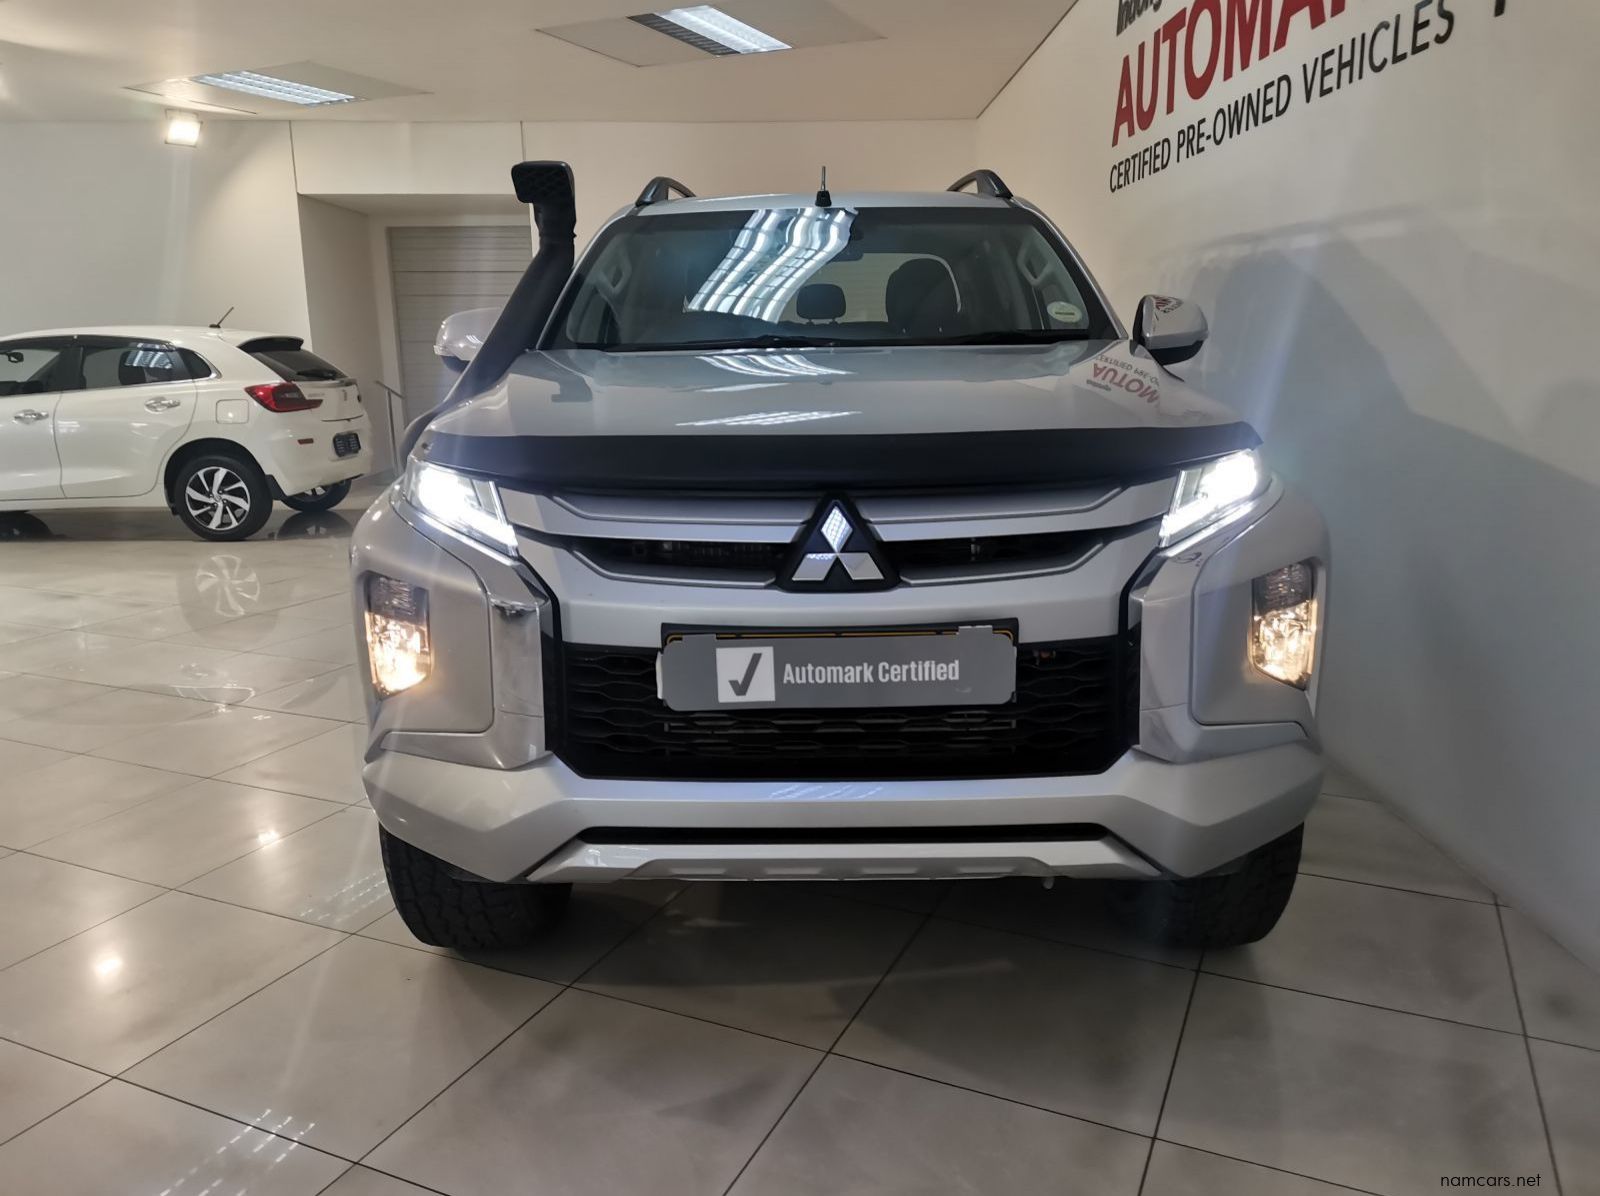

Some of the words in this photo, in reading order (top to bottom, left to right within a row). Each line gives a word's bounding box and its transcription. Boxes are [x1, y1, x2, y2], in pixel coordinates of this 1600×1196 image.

[1109, 137, 1171, 193] CERTIFIED
[1176, 74, 1292, 163] PRE-OWNED
[1302, 0, 1455, 104] VEHICLES
[782, 662, 874, 685] Automark
[878, 660, 960, 683] Certified
